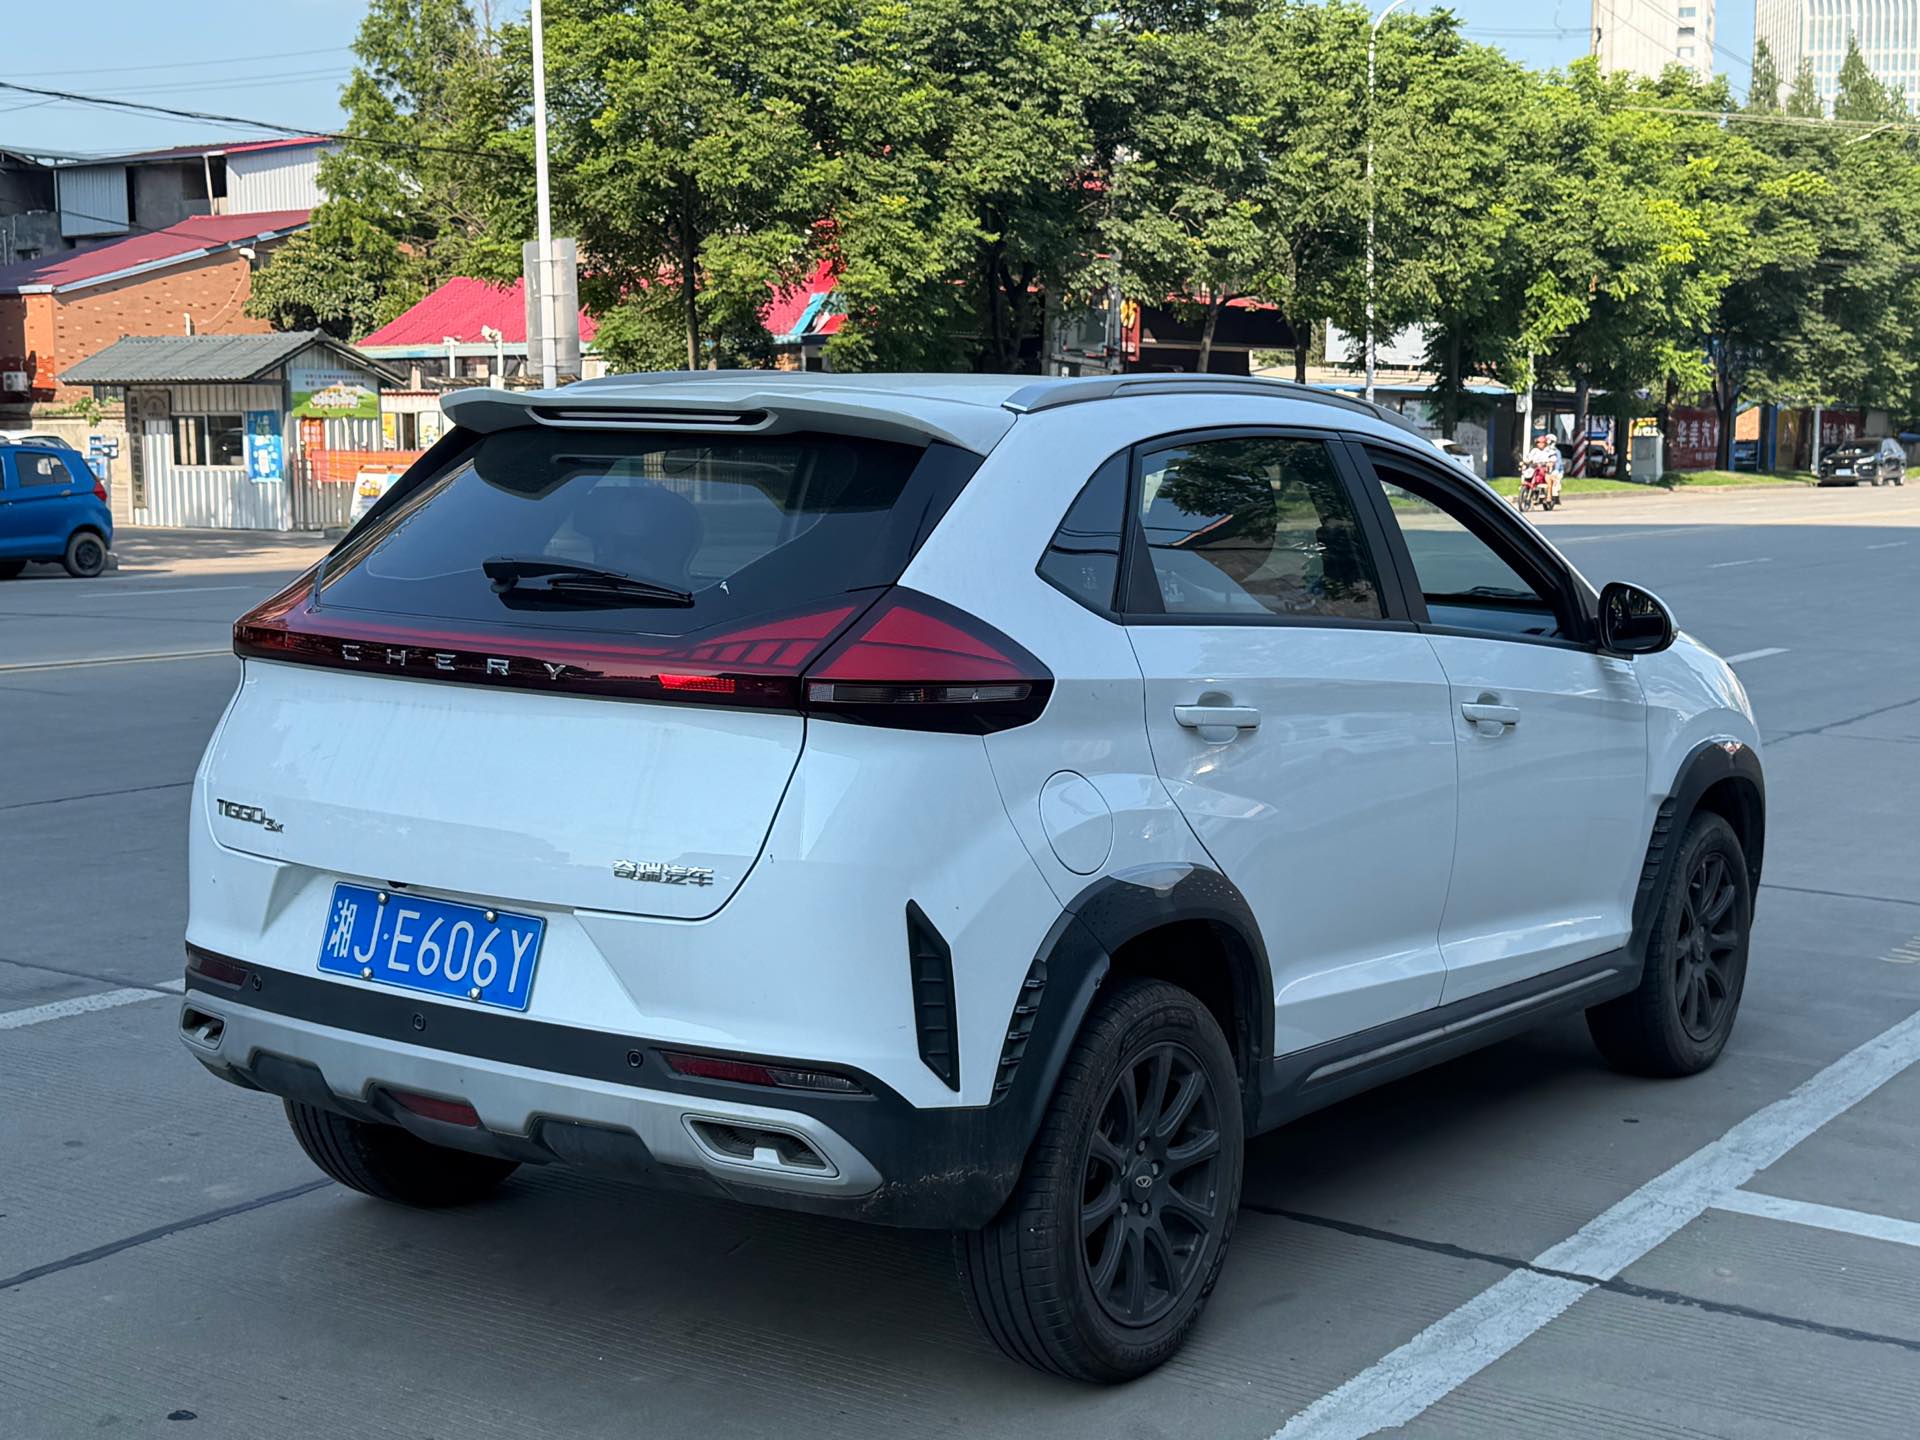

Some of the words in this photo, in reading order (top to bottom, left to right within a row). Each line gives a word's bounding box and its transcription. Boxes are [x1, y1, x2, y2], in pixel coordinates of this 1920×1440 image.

[342, 644, 566, 680] CHERY
[612, 859, 714, 887] 奇瑞汽车
